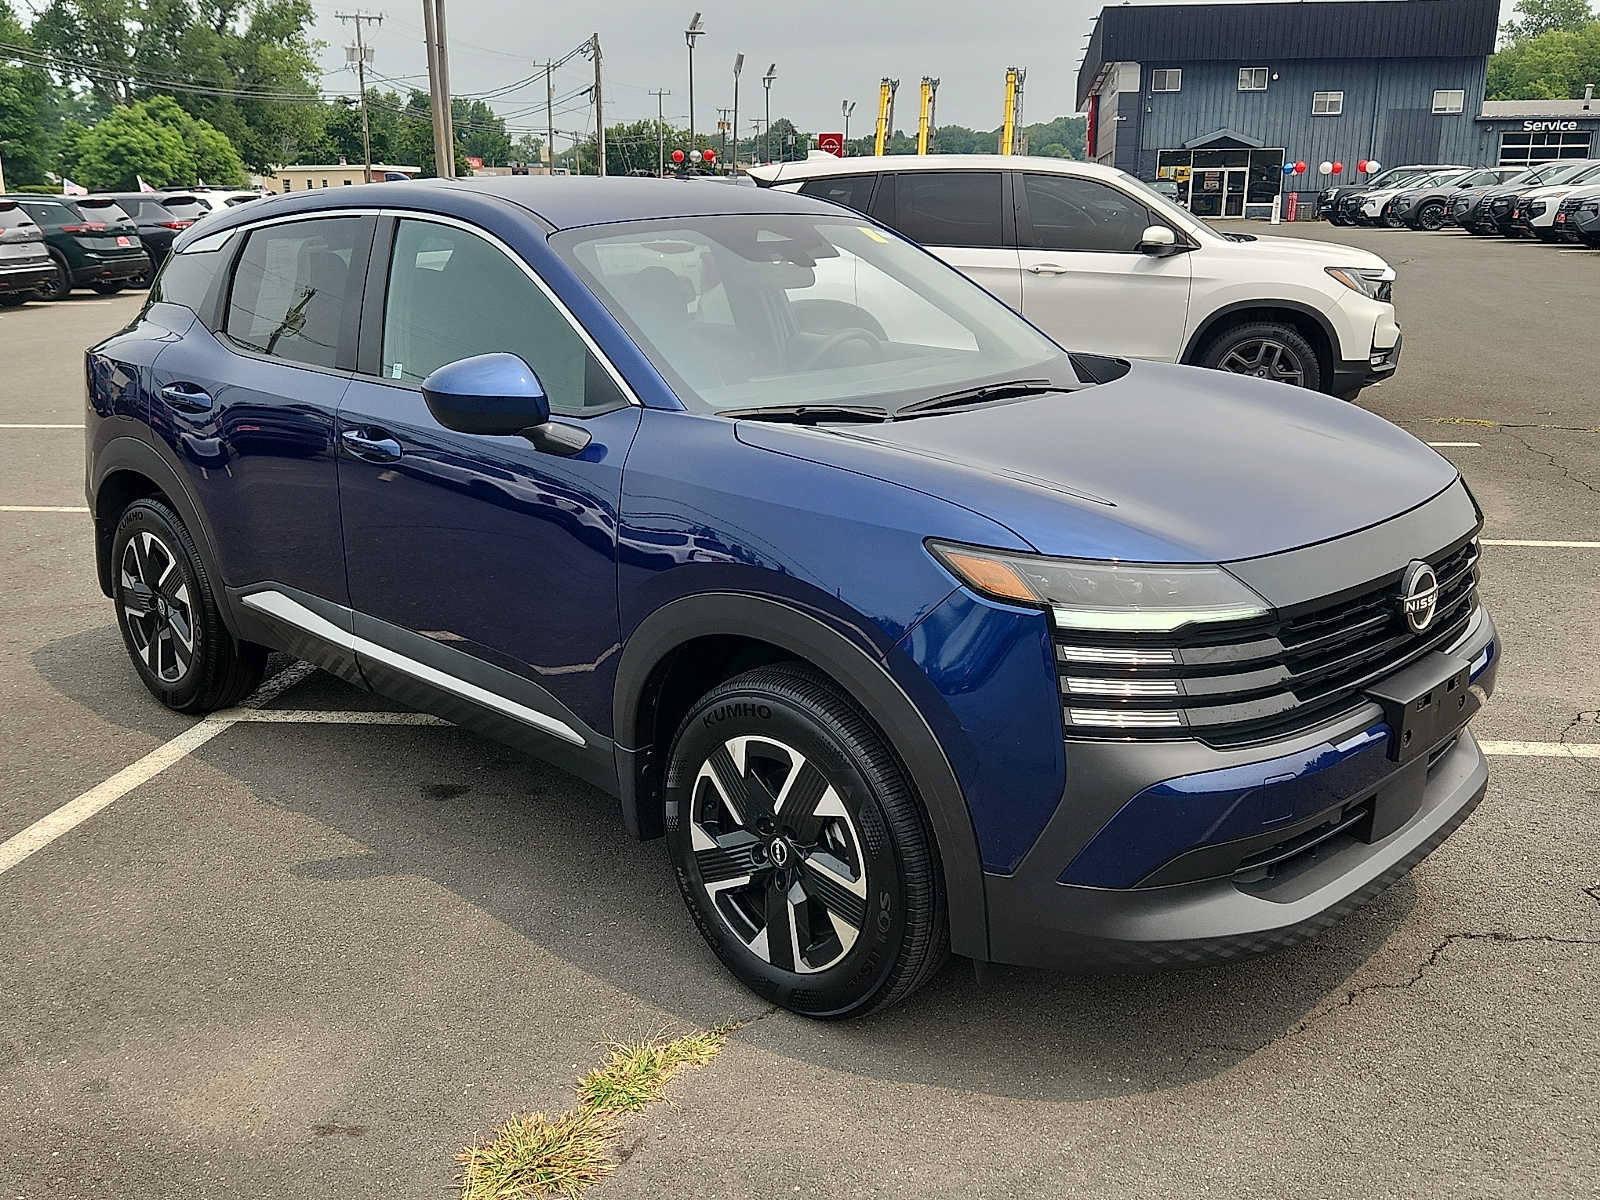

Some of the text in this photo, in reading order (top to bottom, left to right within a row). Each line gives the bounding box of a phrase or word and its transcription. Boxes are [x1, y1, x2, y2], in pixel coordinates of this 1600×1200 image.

[1523, 120, 1578, 131] Service
[1406, 593, 1436, 612] NISS
[702, 702, 773, 728] KUMHO
